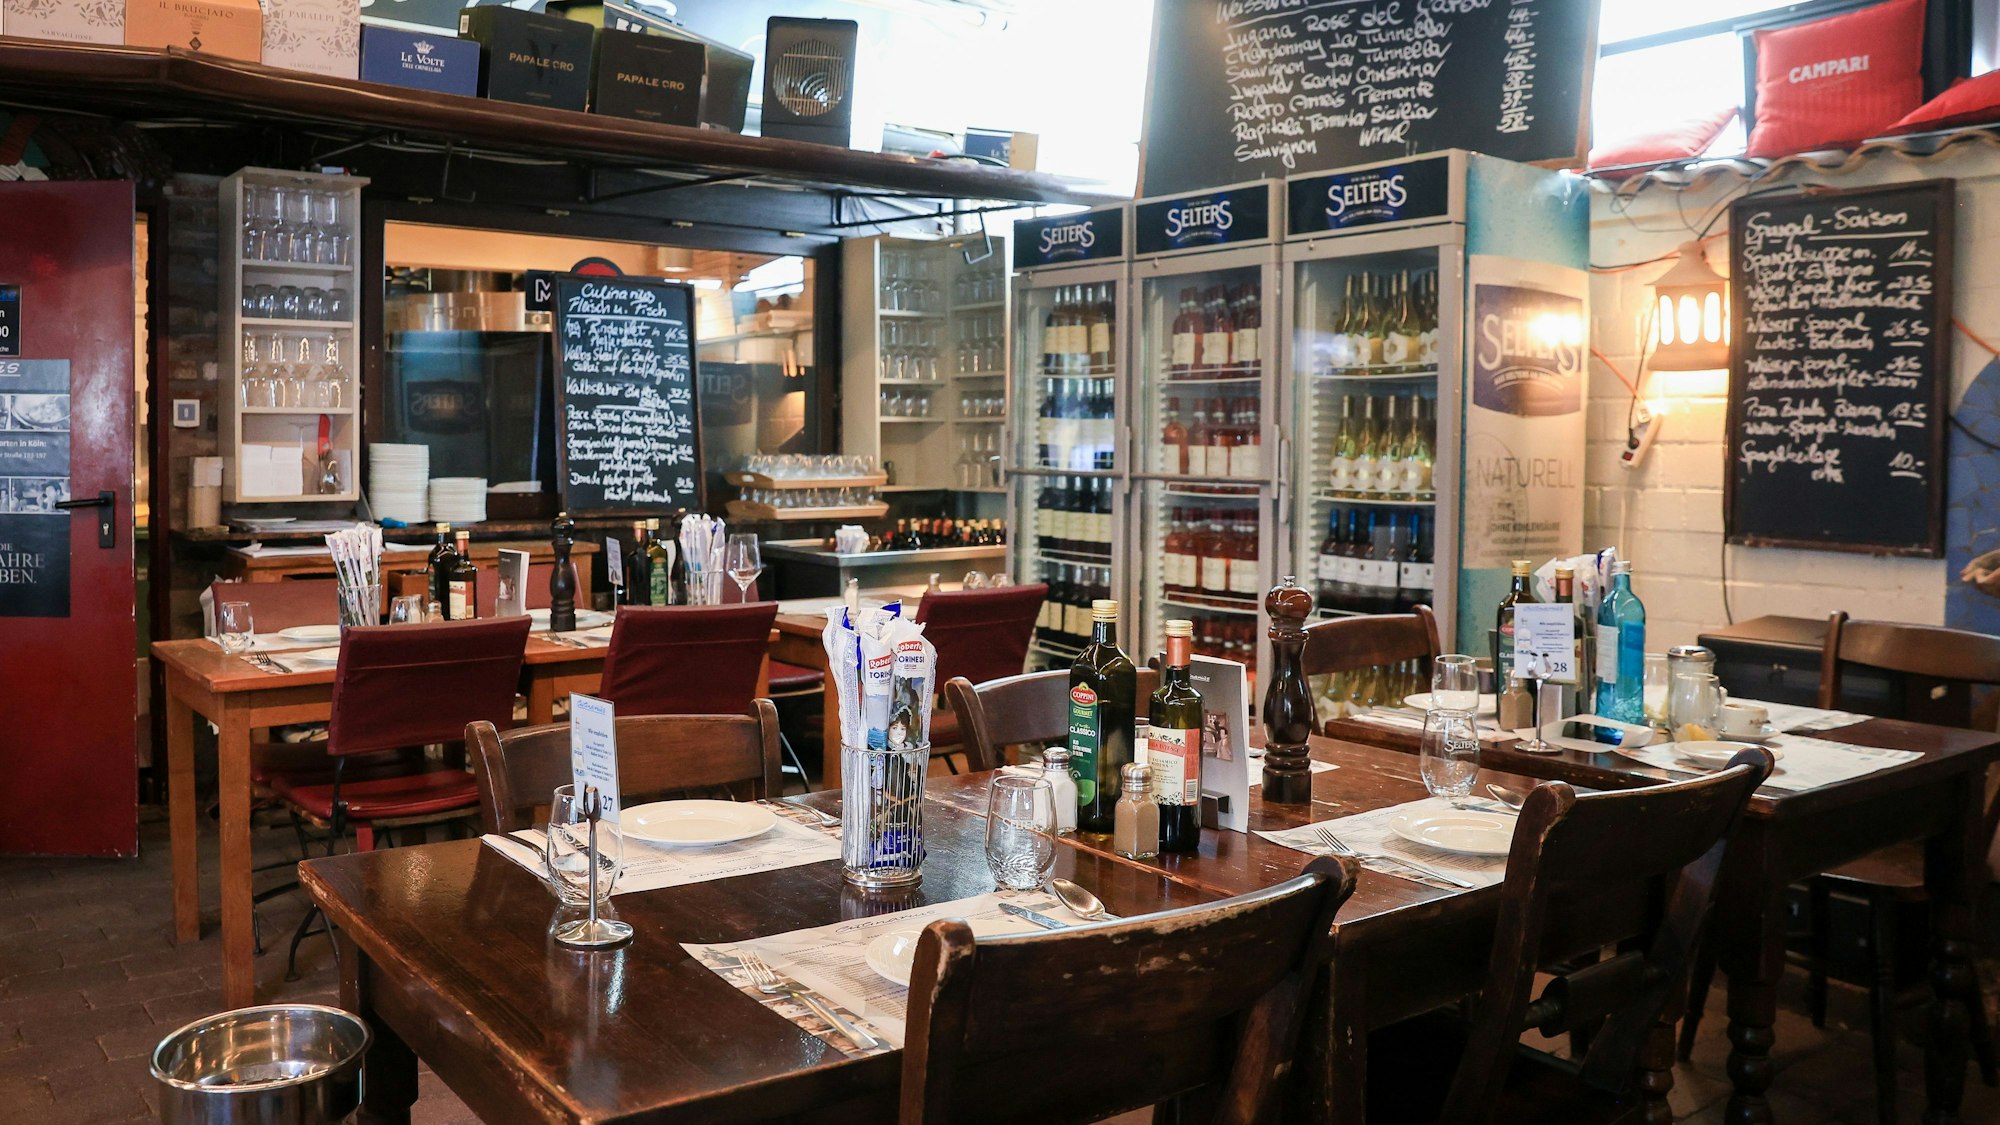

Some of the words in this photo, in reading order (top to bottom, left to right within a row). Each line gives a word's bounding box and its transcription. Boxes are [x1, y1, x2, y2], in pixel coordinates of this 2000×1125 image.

[1222, 24, 1297, 51] Lugana
[1361, 1, 1403, 27] del
[416, 53, 445, 68] VOLTE
[509, 52, 550, 68] PAPALE
[1788, 55, 1869, 84] CAMPARI
[616, 72, 660, 87] PAPALE
[1351, 79, 1434, 105] Piemonte
[1370, 102, 1438, 123] Sicilia
[1234, 140, 1318, 168] Sauvignon
[1325, 174, 1407, 216] SELTERS
[1165, 200, 1233, 237] SELTERS
[1038, 221, 1095, 253] SELTERS
[568, 296, 610, 315] Fleisch
[630, 300, 667, 317] Fisch
[1477, 457, 1575, 489] NATURELL
[1553, 662, 1568, 673] 28
[1069, 725, 1096, 737] CLASSICO
[602, 795, 613, 813] 27
